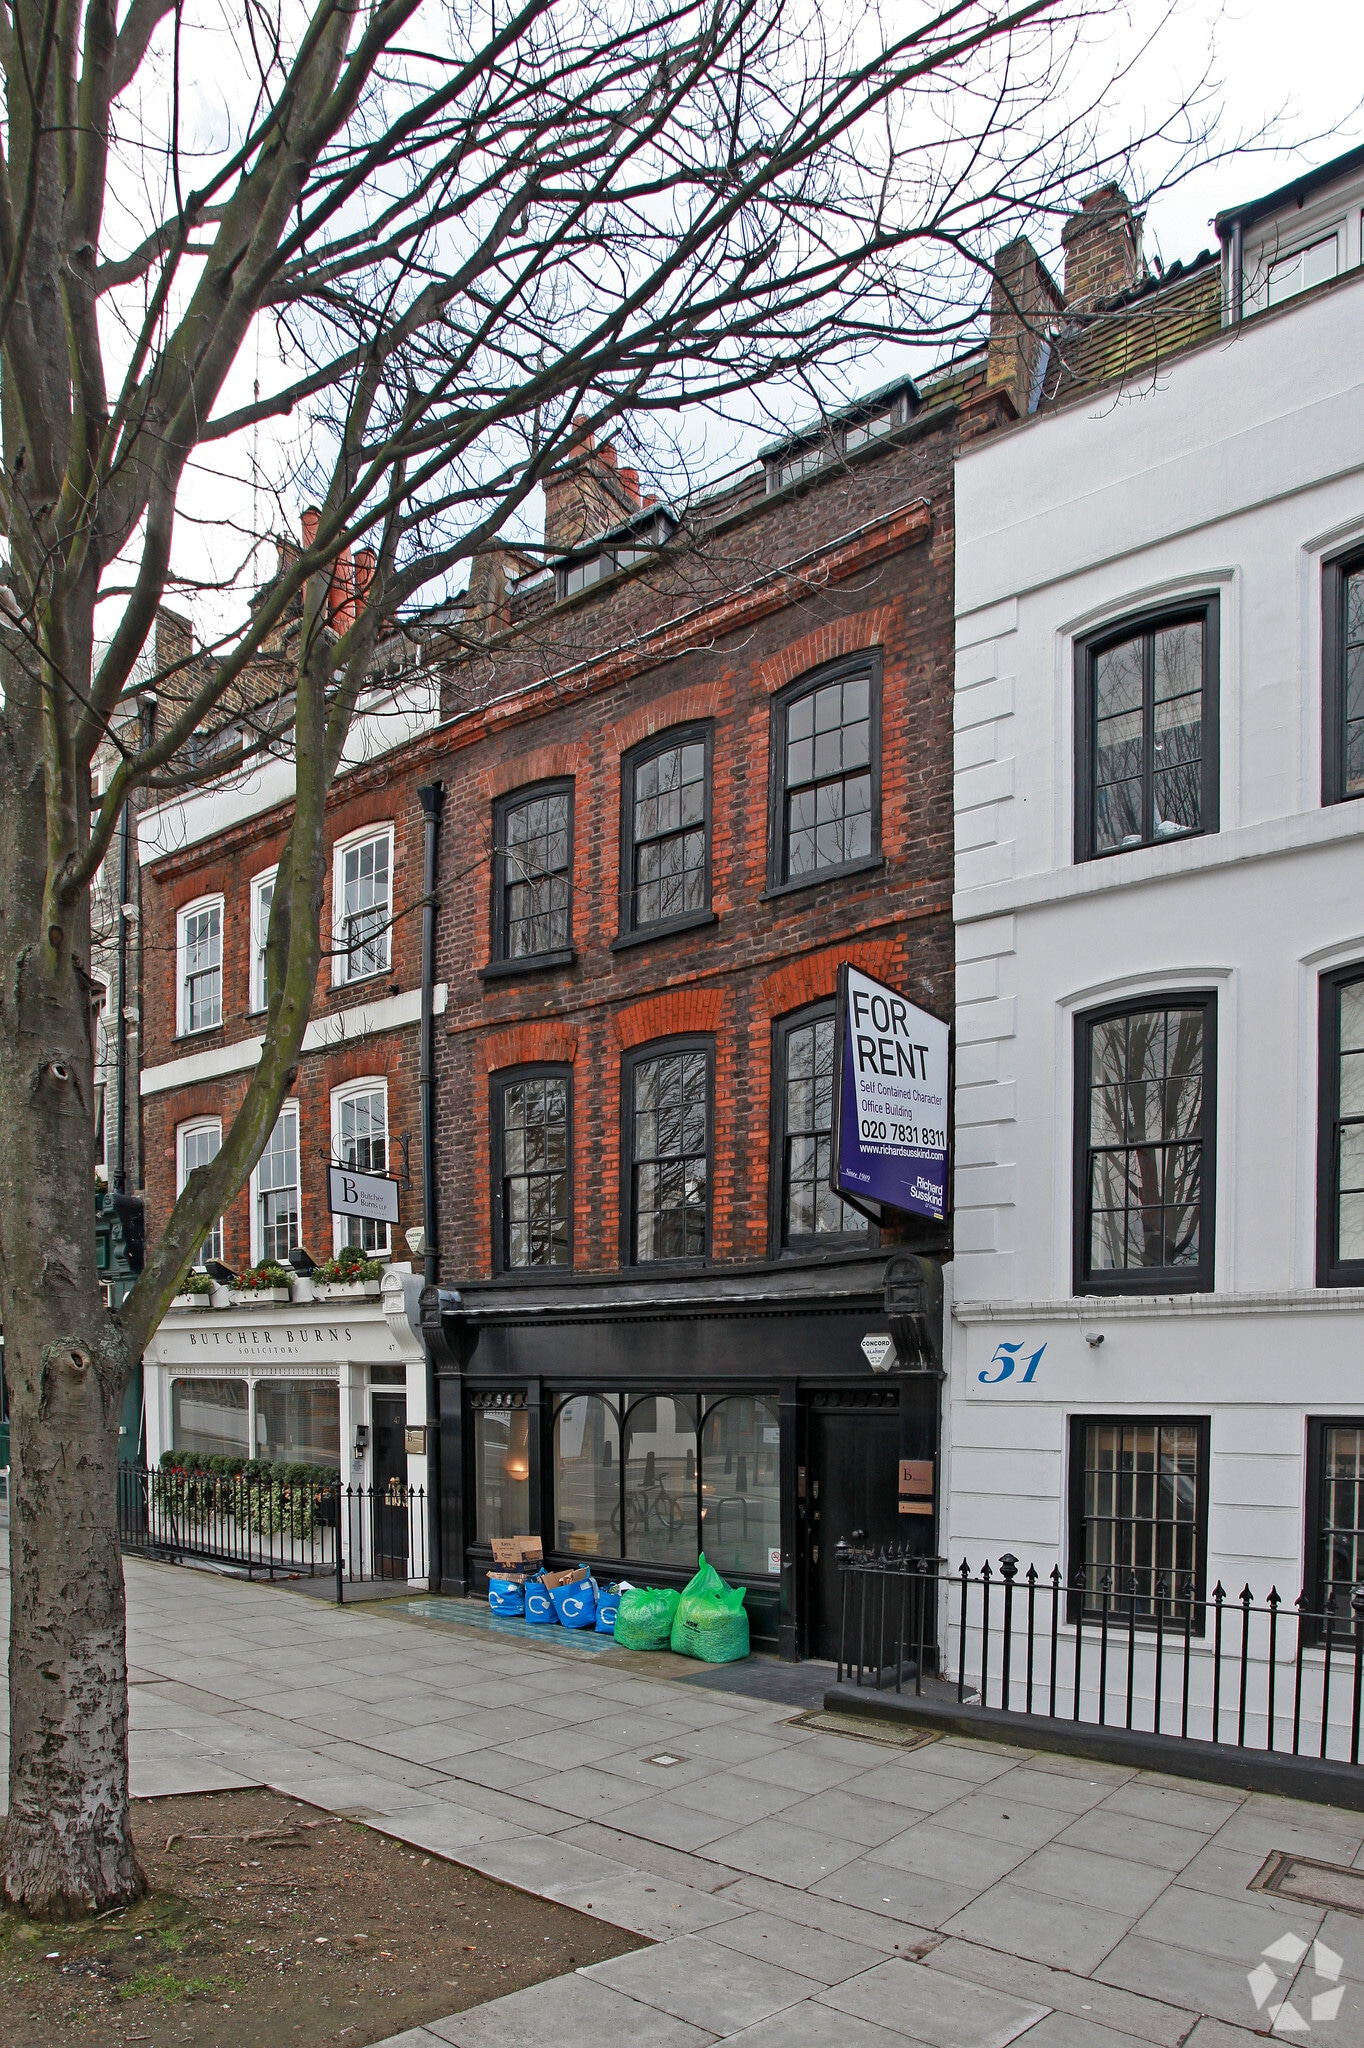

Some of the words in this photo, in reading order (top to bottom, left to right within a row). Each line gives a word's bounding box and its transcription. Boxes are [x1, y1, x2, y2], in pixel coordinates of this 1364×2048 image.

[852, 990, 910, 1037] FOR
[857, 1034, 929, 1081] RENT
[860, 1080, 876, 1094] Self
[877, 1083, 911, 1100] Contained
[912, 1089, 943, 1106] Character
[861, 1099, 883, 1114] Office
[885, 1103, 913, 1121] Building
[861, 1119, 887, 1140] 020
[890, 1123, 919, 1143] 7831
[921, 1127, 945, 1147] 8311
[859, 1144, 944, 1161] www.richardsusskind.com
[846, 1168, 859, 1178] Since
[341, 1176, 358, 1204] B
[360, 1191, 383, 1201] Butcher
[909, 1185, 943, 1208] Susskind
[916, 1175, 943, 1196] Richard
[361, 1199, 378, 1208] Burns
[189, 1331, 273, 1345] BUTCHER
[286, 1327, 353, 1343] BURNS
[238, 1346, 299, 1354] SOLICITORS
[978, 1341, 1047, 1383] 51
